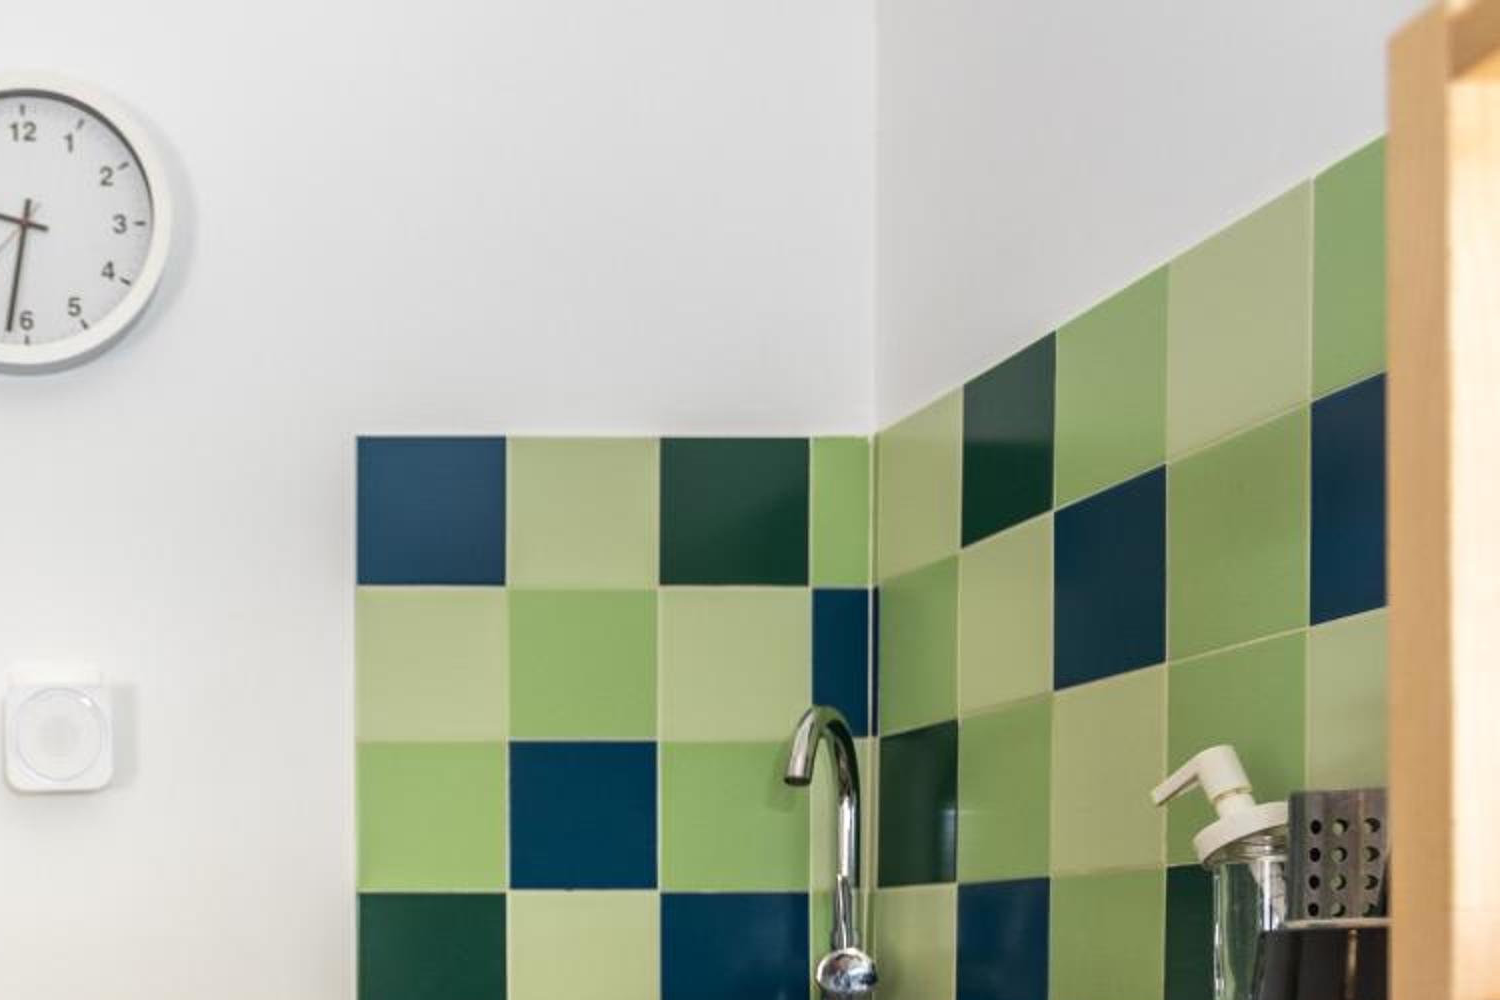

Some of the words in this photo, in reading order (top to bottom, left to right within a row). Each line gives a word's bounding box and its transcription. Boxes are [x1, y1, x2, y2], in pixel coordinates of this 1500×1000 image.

[10, 121, 37, 142] 12
[64, 133, 75, 153] 1
[100, 166, 114, 187] 2
[113, 214, 127, 234] 3
[100, 261, 116, 281] 4
[67, 297, 82, 318] 5
[19, 311, 34, 331] 6
